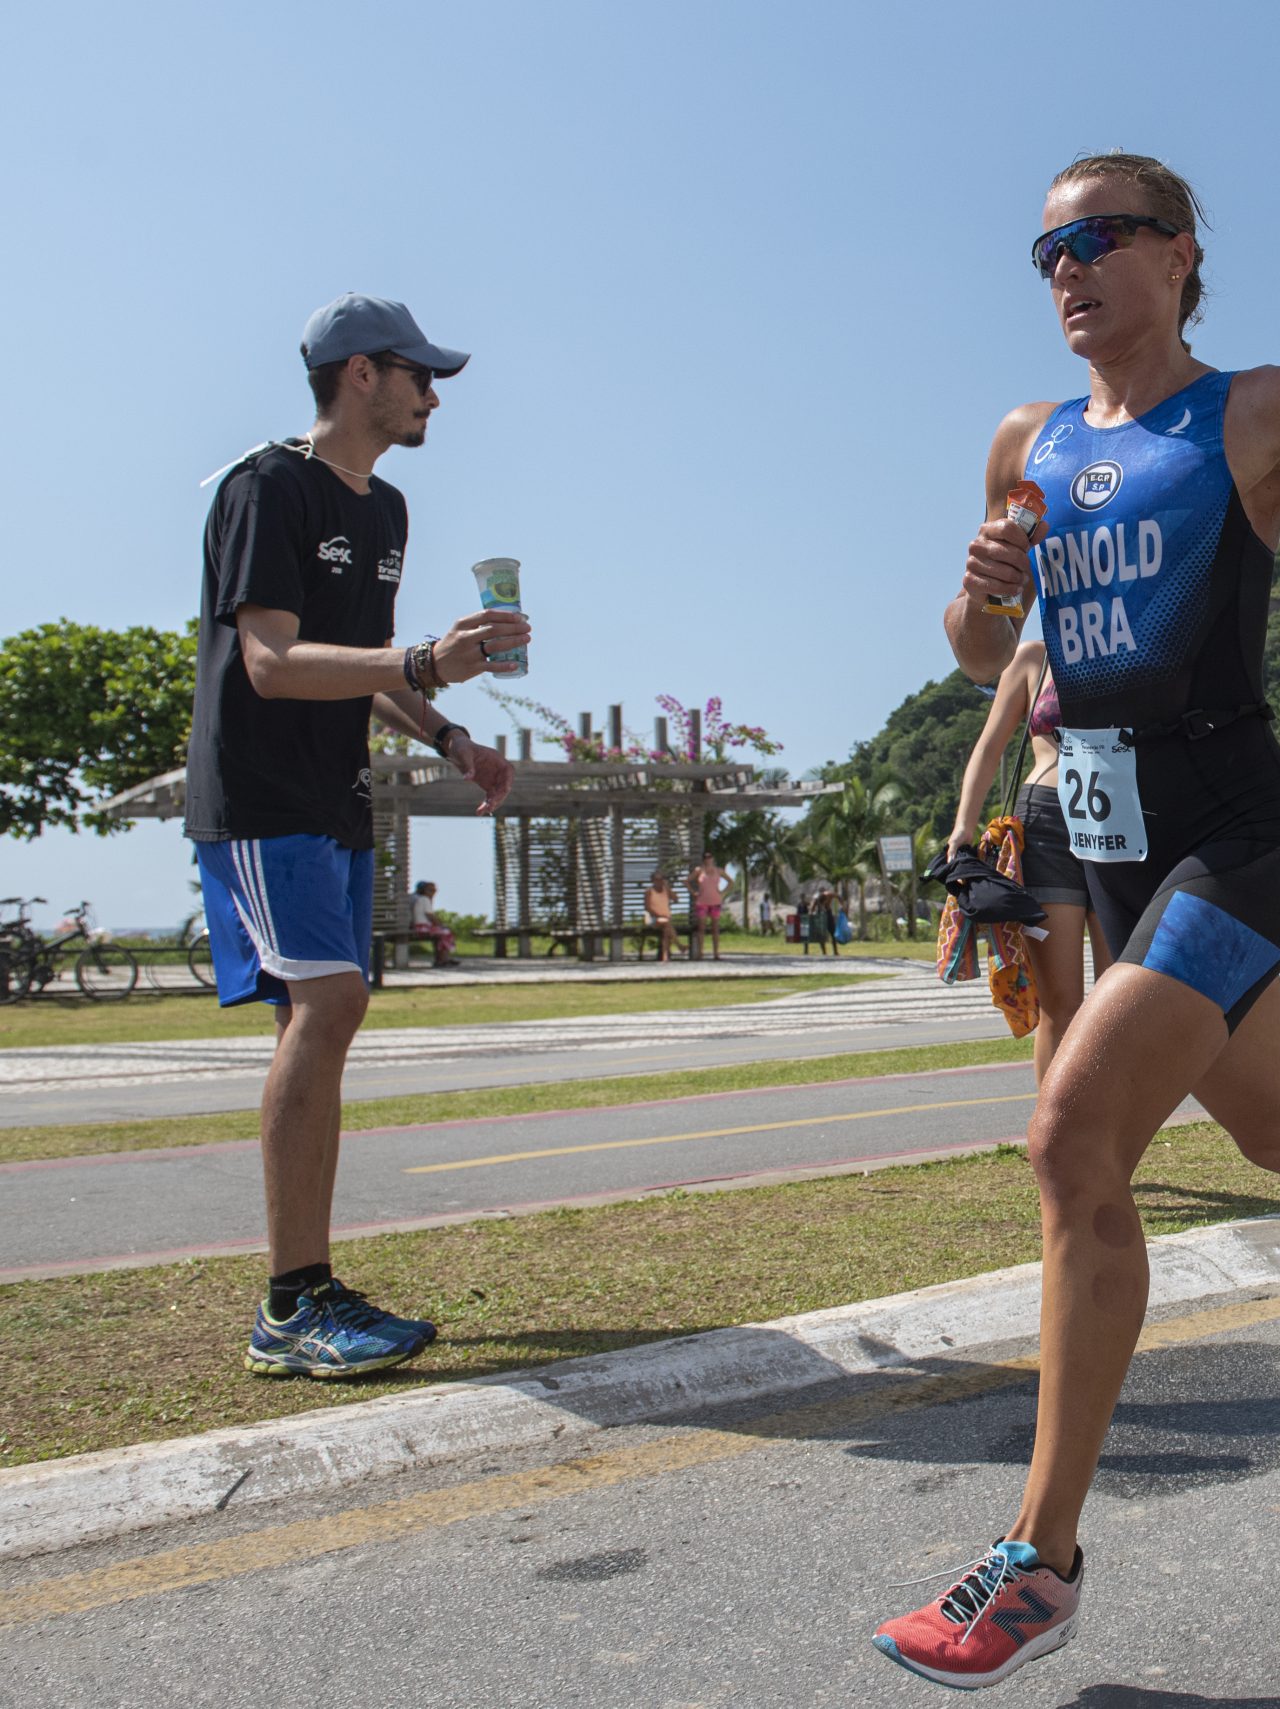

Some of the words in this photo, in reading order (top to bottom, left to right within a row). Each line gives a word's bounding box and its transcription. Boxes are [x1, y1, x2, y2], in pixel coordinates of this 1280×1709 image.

[1034, 519, 1163, 599] ARNOLD
[1058, 596, 1137, 665] BRA
[1065, 768, 1111, 822] 26
[1073, 832, 1127, 851] JENYFER
